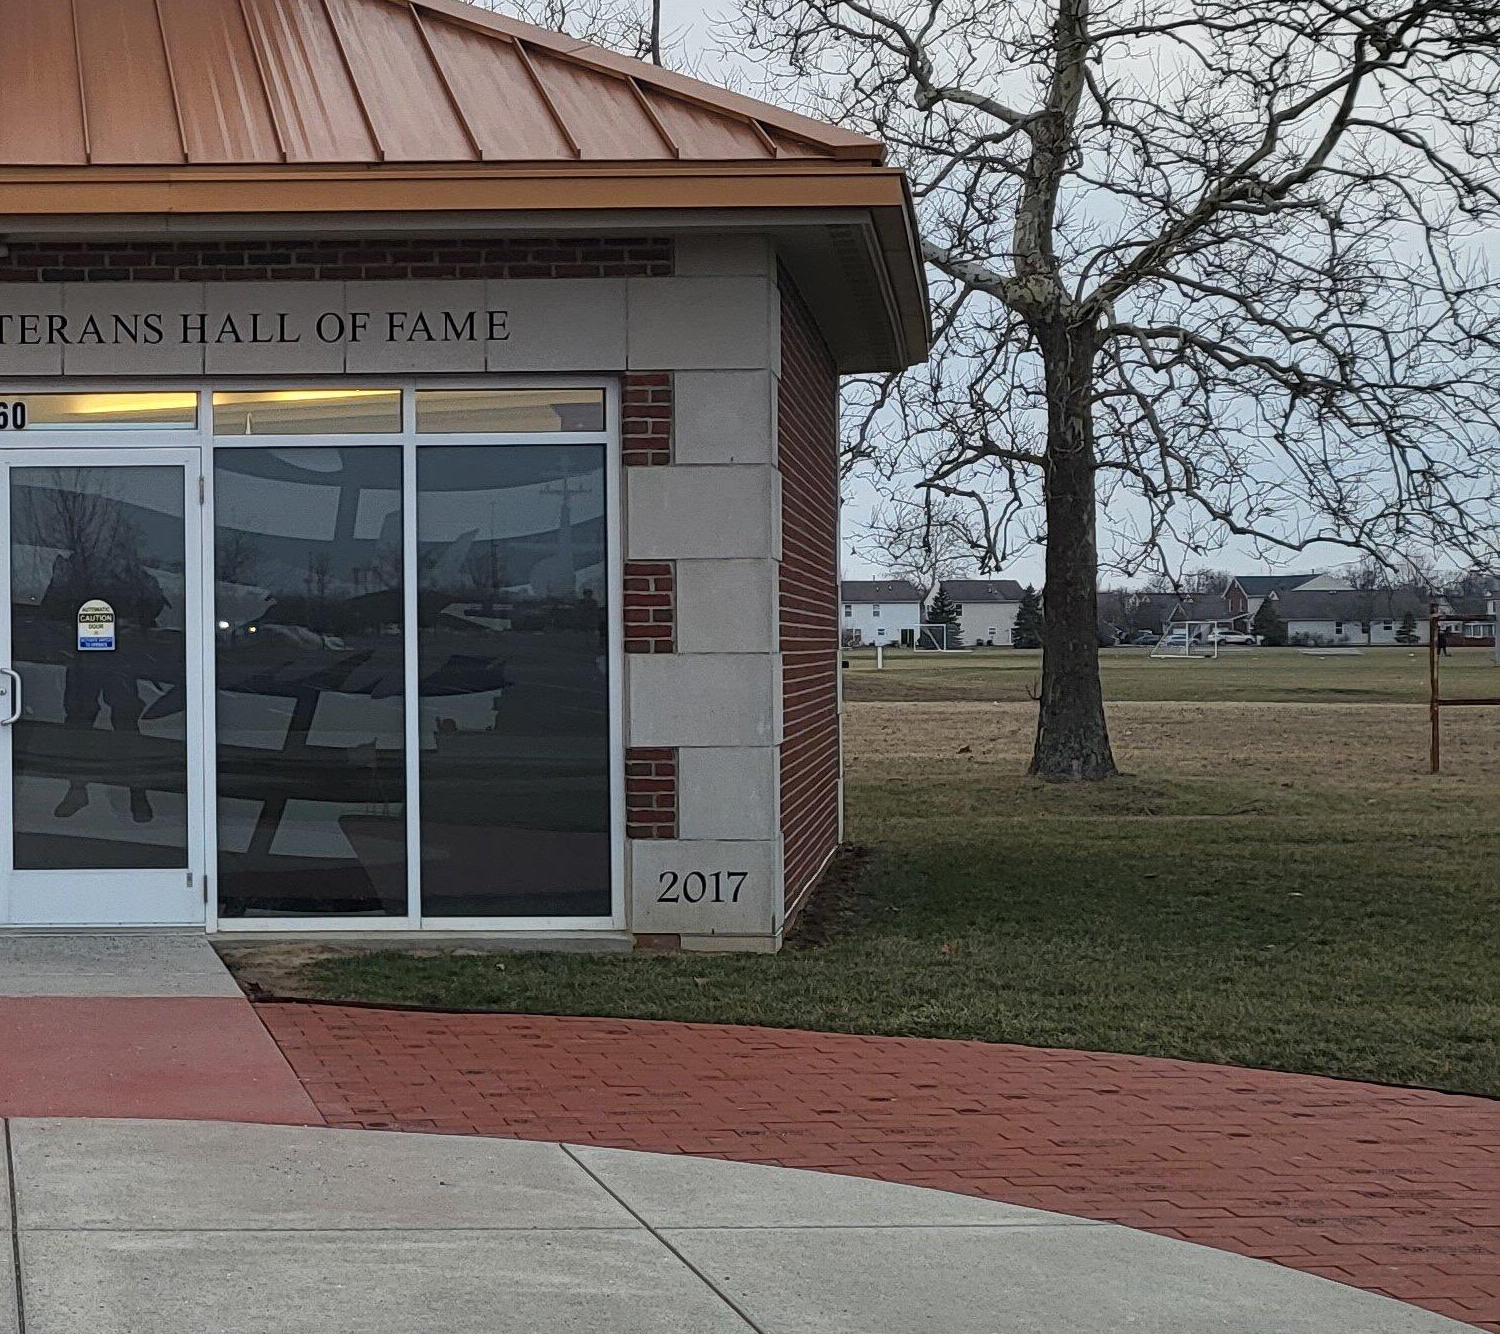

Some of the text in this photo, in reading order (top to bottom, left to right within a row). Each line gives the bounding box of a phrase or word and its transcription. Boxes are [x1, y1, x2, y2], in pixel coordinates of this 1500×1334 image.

[180, 312, 301, 344] HALL
[314, 310, 371, 344] OF
[385, 309, 511, 343] FAME
[657, 870, 749, 904] 2017
